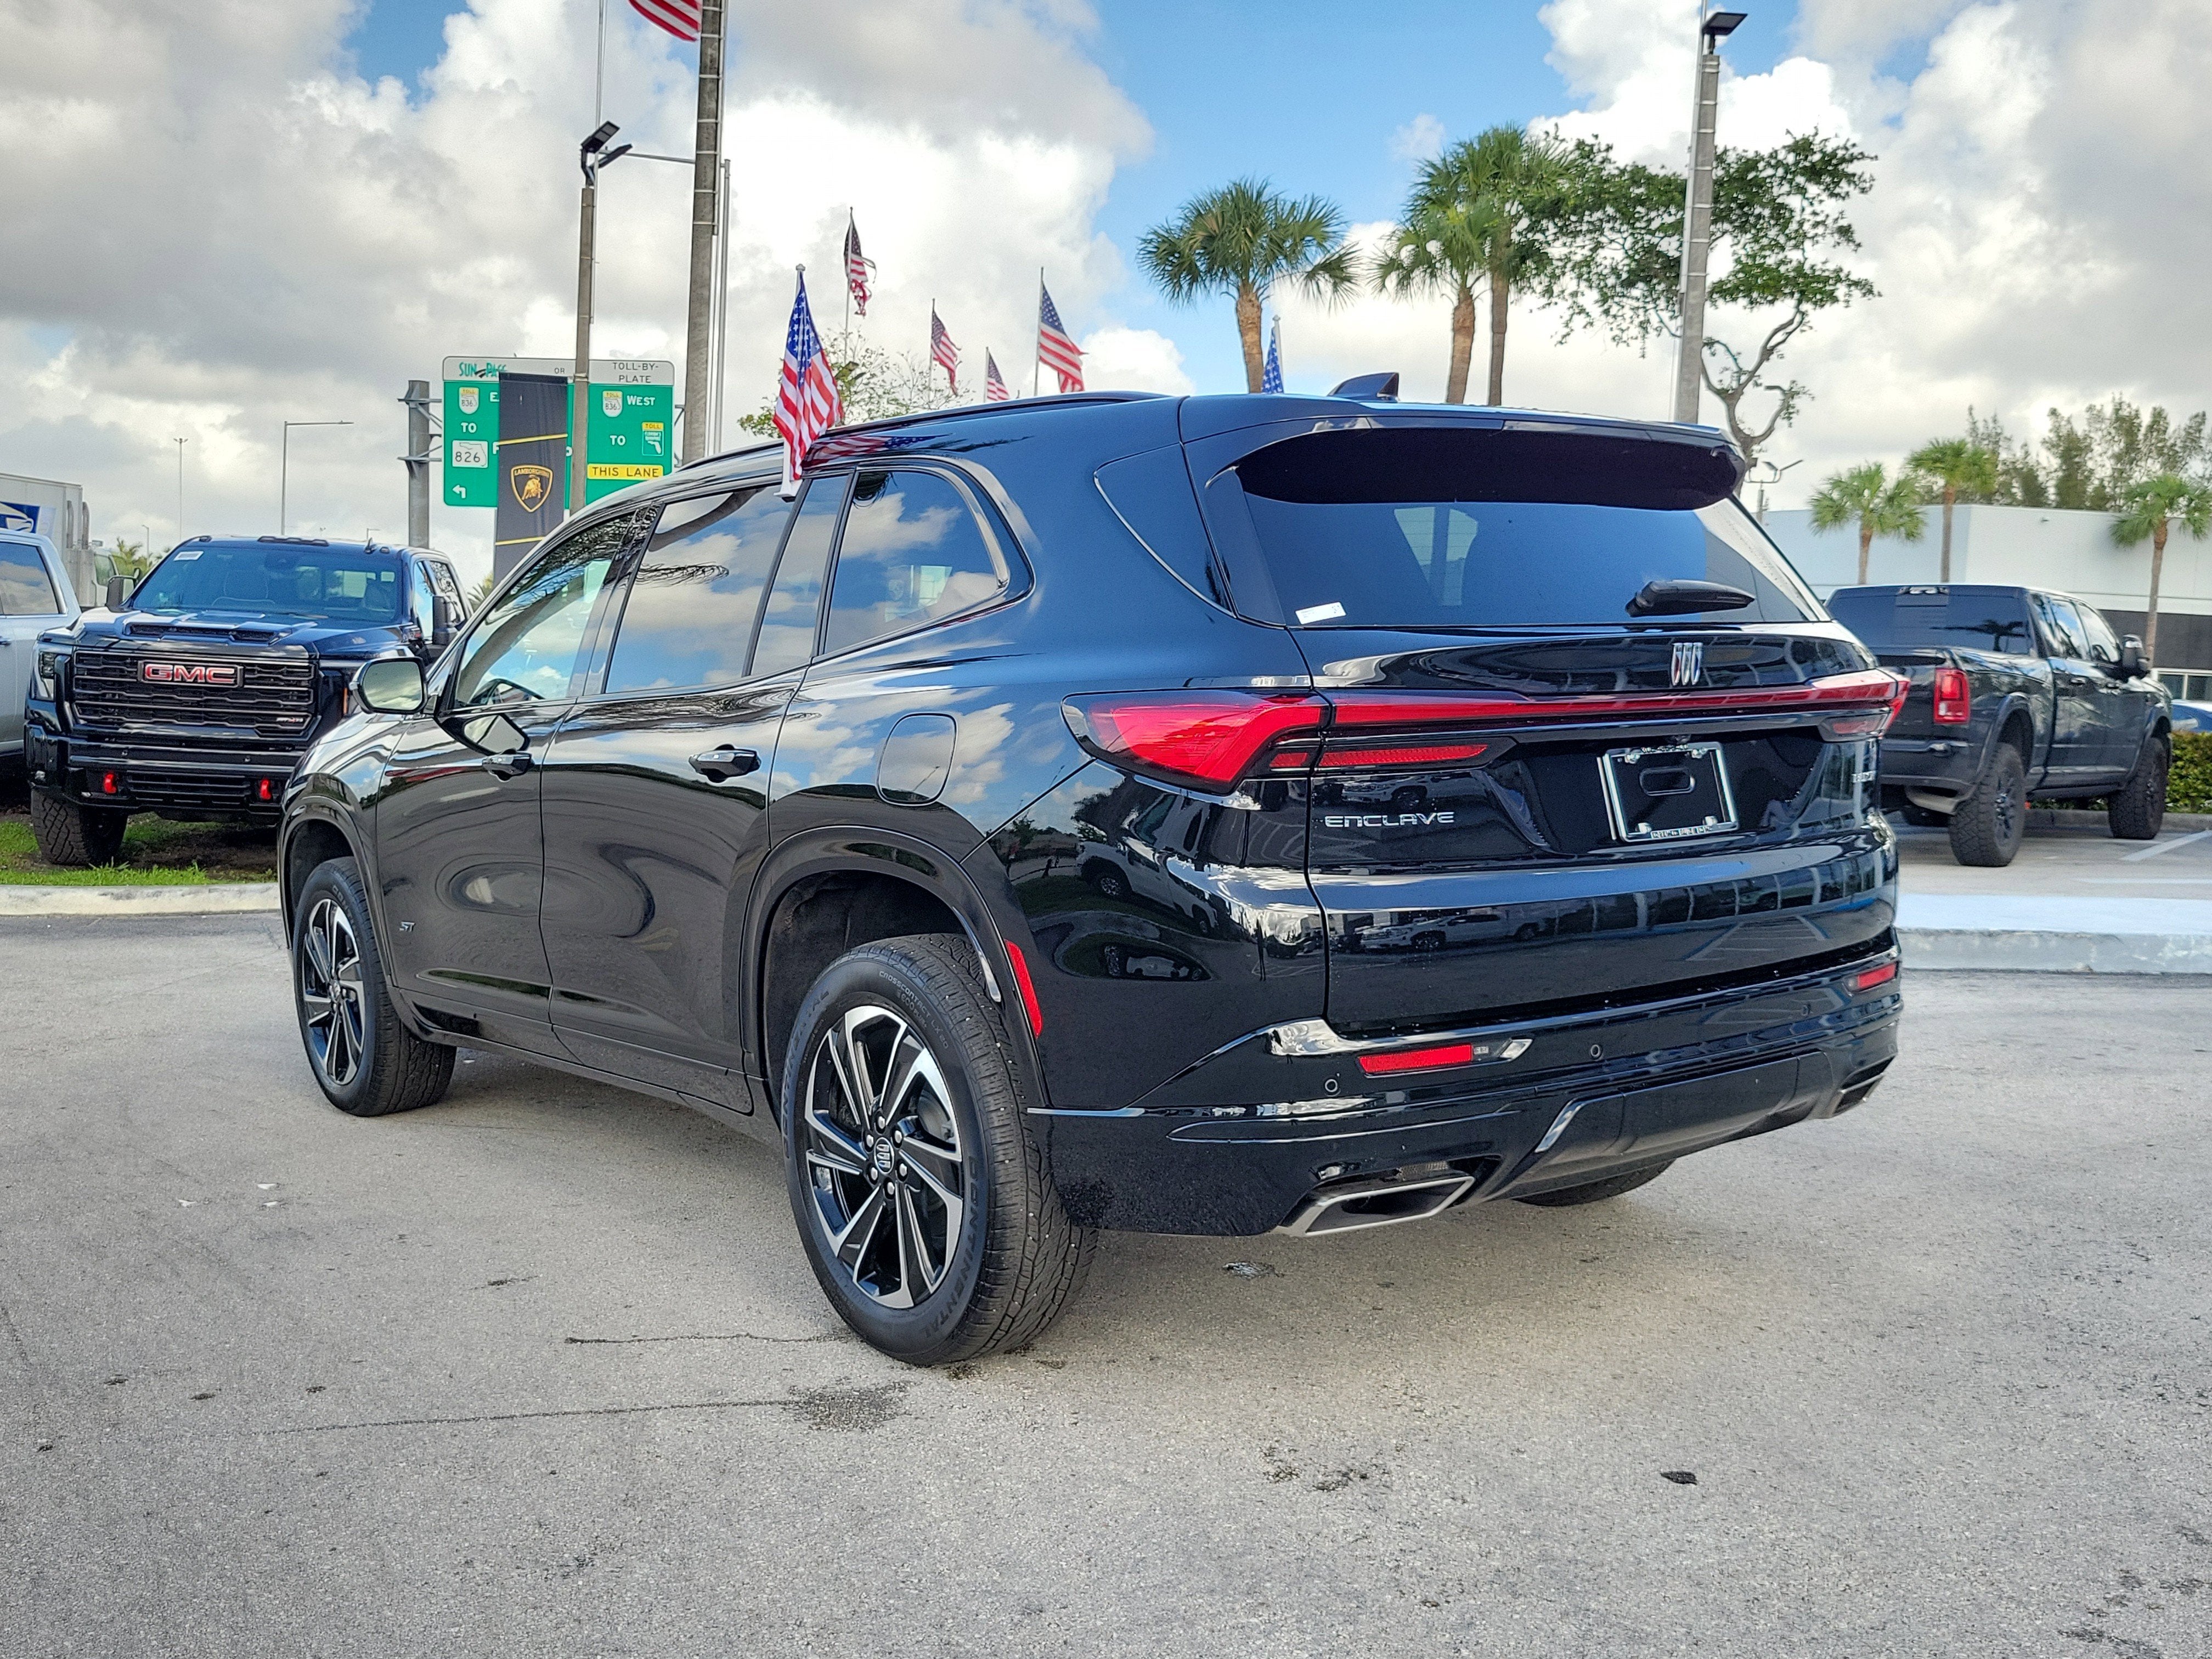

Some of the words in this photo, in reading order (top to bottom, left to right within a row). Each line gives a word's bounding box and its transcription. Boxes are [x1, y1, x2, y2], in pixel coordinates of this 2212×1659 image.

[459, 362, 477, 377] SUN
[613, 362, 659, 371] TOLL-BY-
[618, 375, 651, 383] PLATE
[627, 395, 656, 406] WEST
[461, 422, 477, 433] TO
[610, 435, 625, 445] TO
[455, 452, 481, 462] 826
[592, 467, 619, 476] THIS
[626, 467, 659, 477] LANE
[145, 663, 235, 684] GMC
[1324, 811, 1454, 828] ENCLAVE
[399, 921, 416, 932] ST
[879, 970, 932, 1019] CROSSCONTACT
